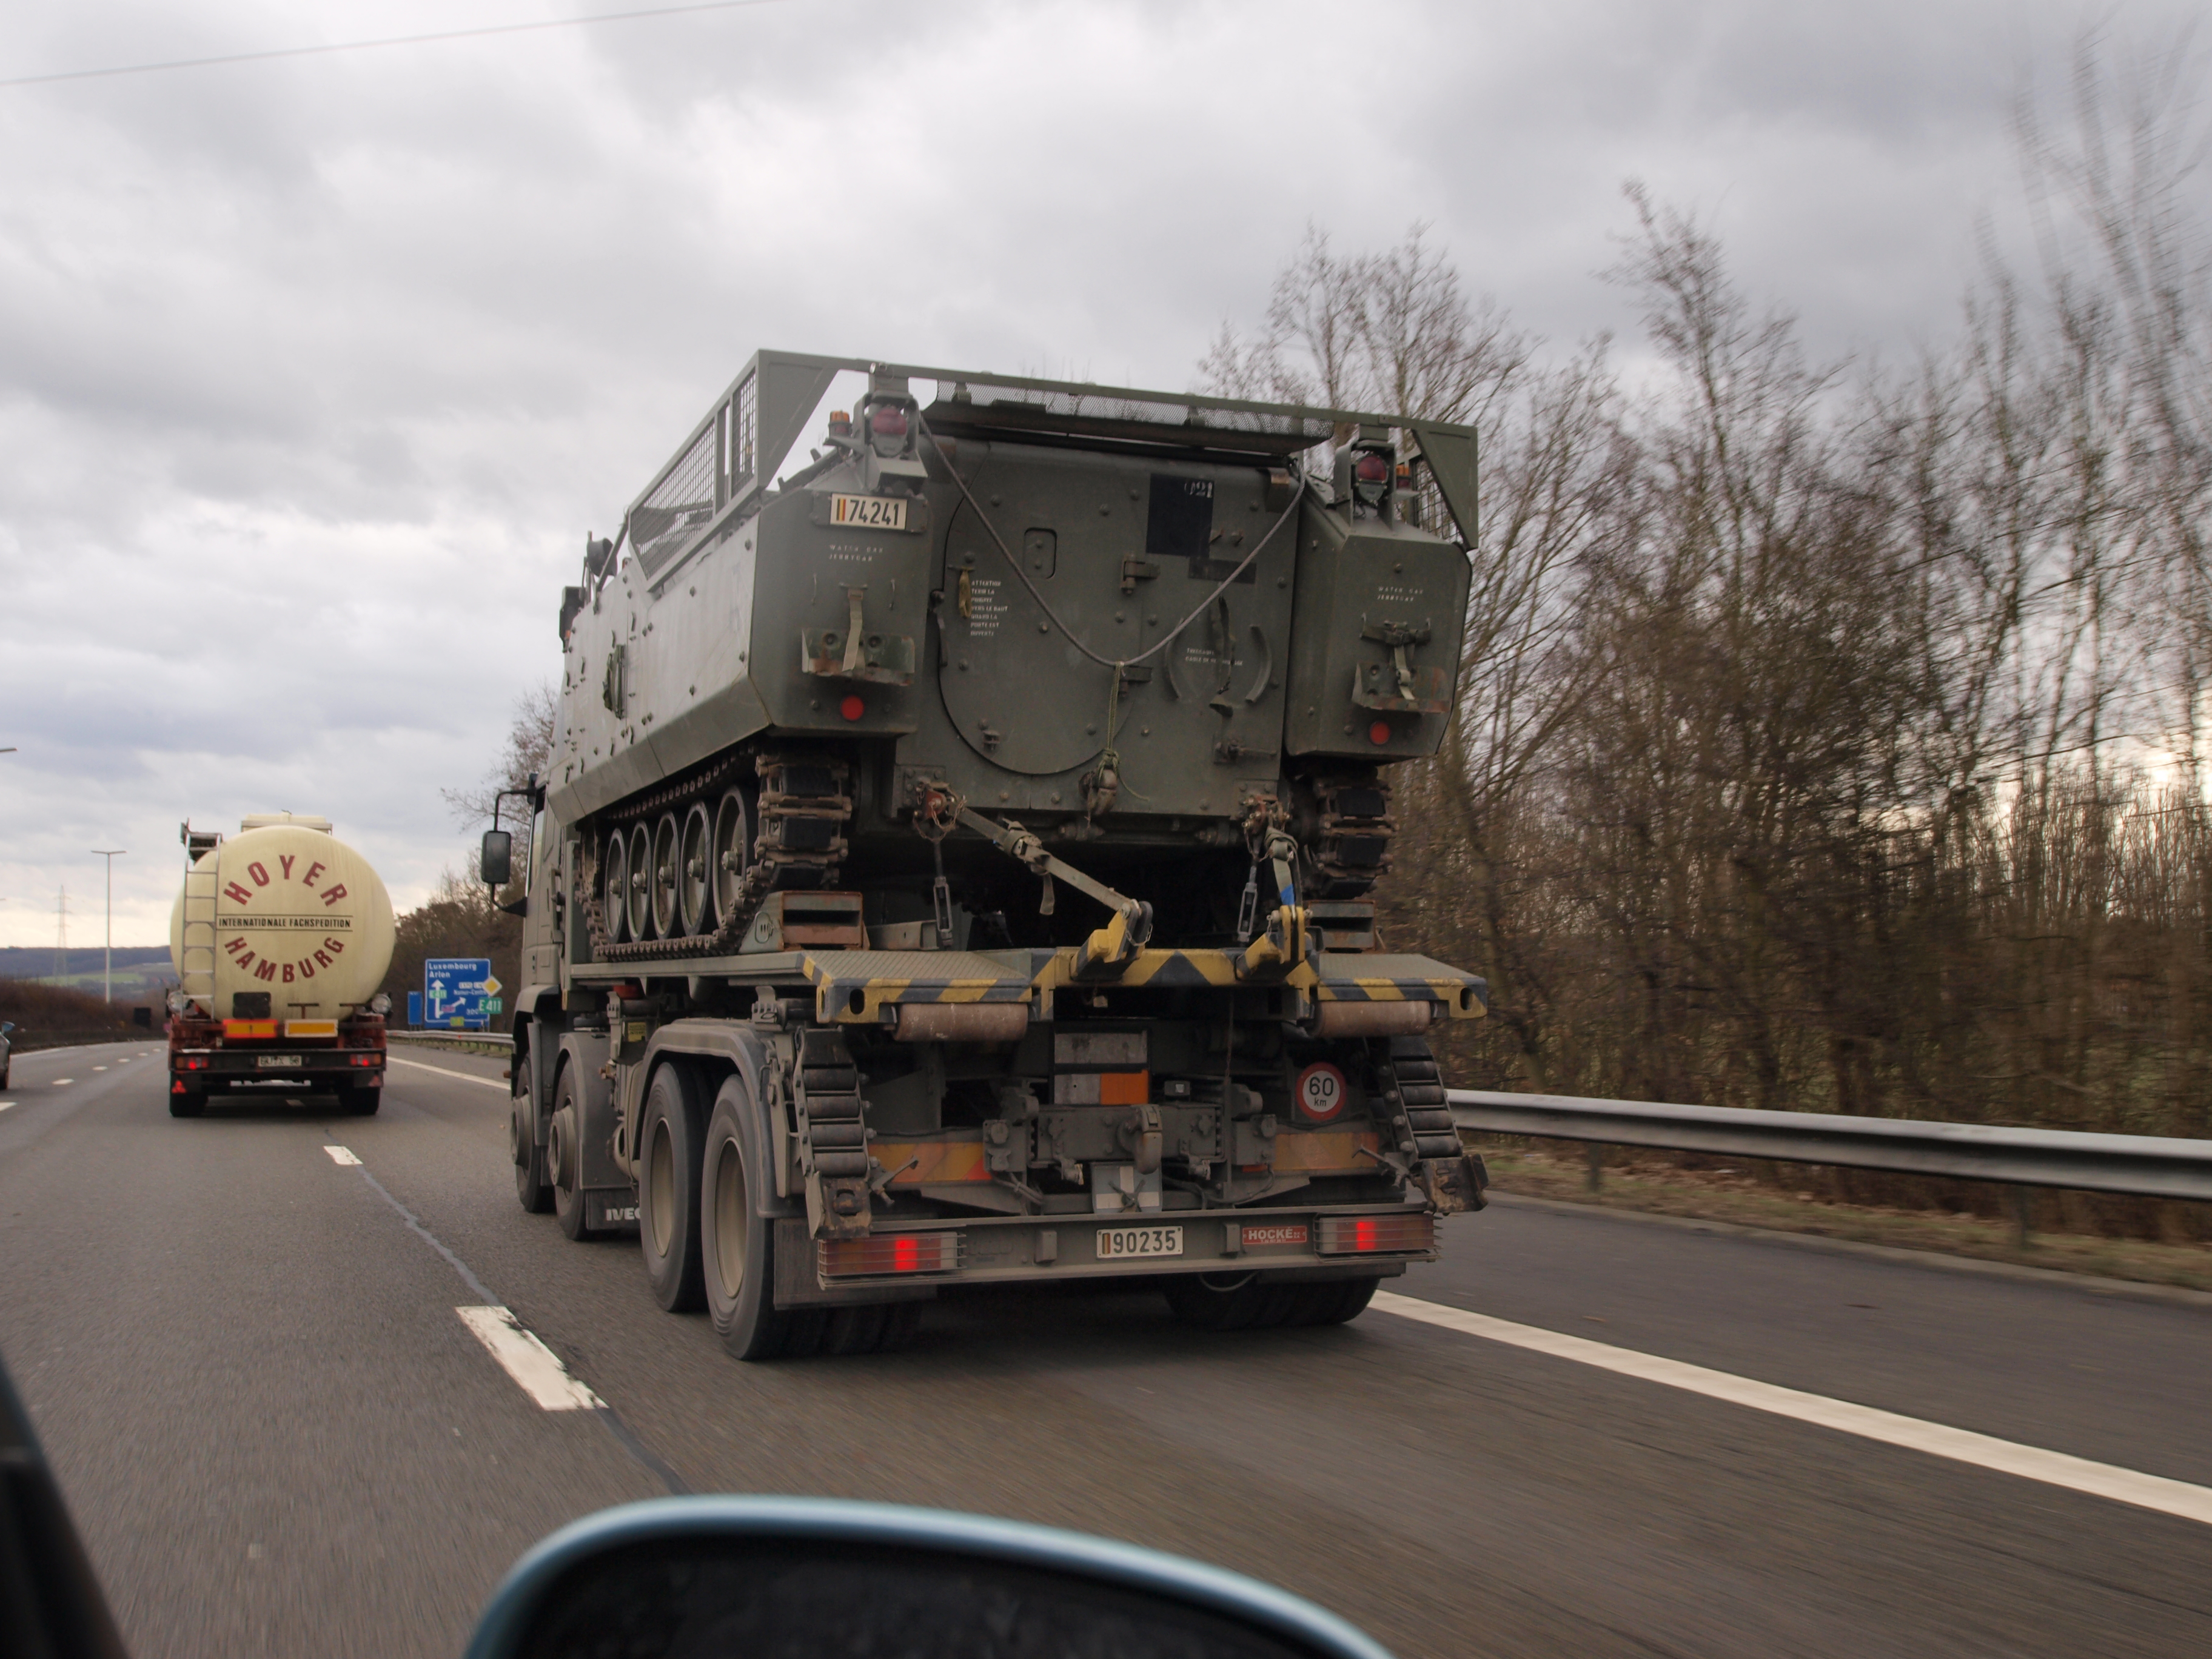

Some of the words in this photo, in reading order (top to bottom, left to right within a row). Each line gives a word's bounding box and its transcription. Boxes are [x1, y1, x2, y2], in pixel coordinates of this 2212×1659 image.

[849, 498, 899, 526] 74241
[223, 855, 347, 907] HOYER
[219, 918, 286, 927] INTERNATIONALE
[289, 919, 350, 928] FACHSPEDITION
[224, 937, 344, 983] HAMBURG
[429, 962, 477, 971] Luxembourg
[1309, 1076, 1334, 1097] 60
[1314, 1097, 1327, 1107] km
[1113, 1230, 1176, 1253] 90235
[1248, 1227, 1293, 1240] HOCKÉ
